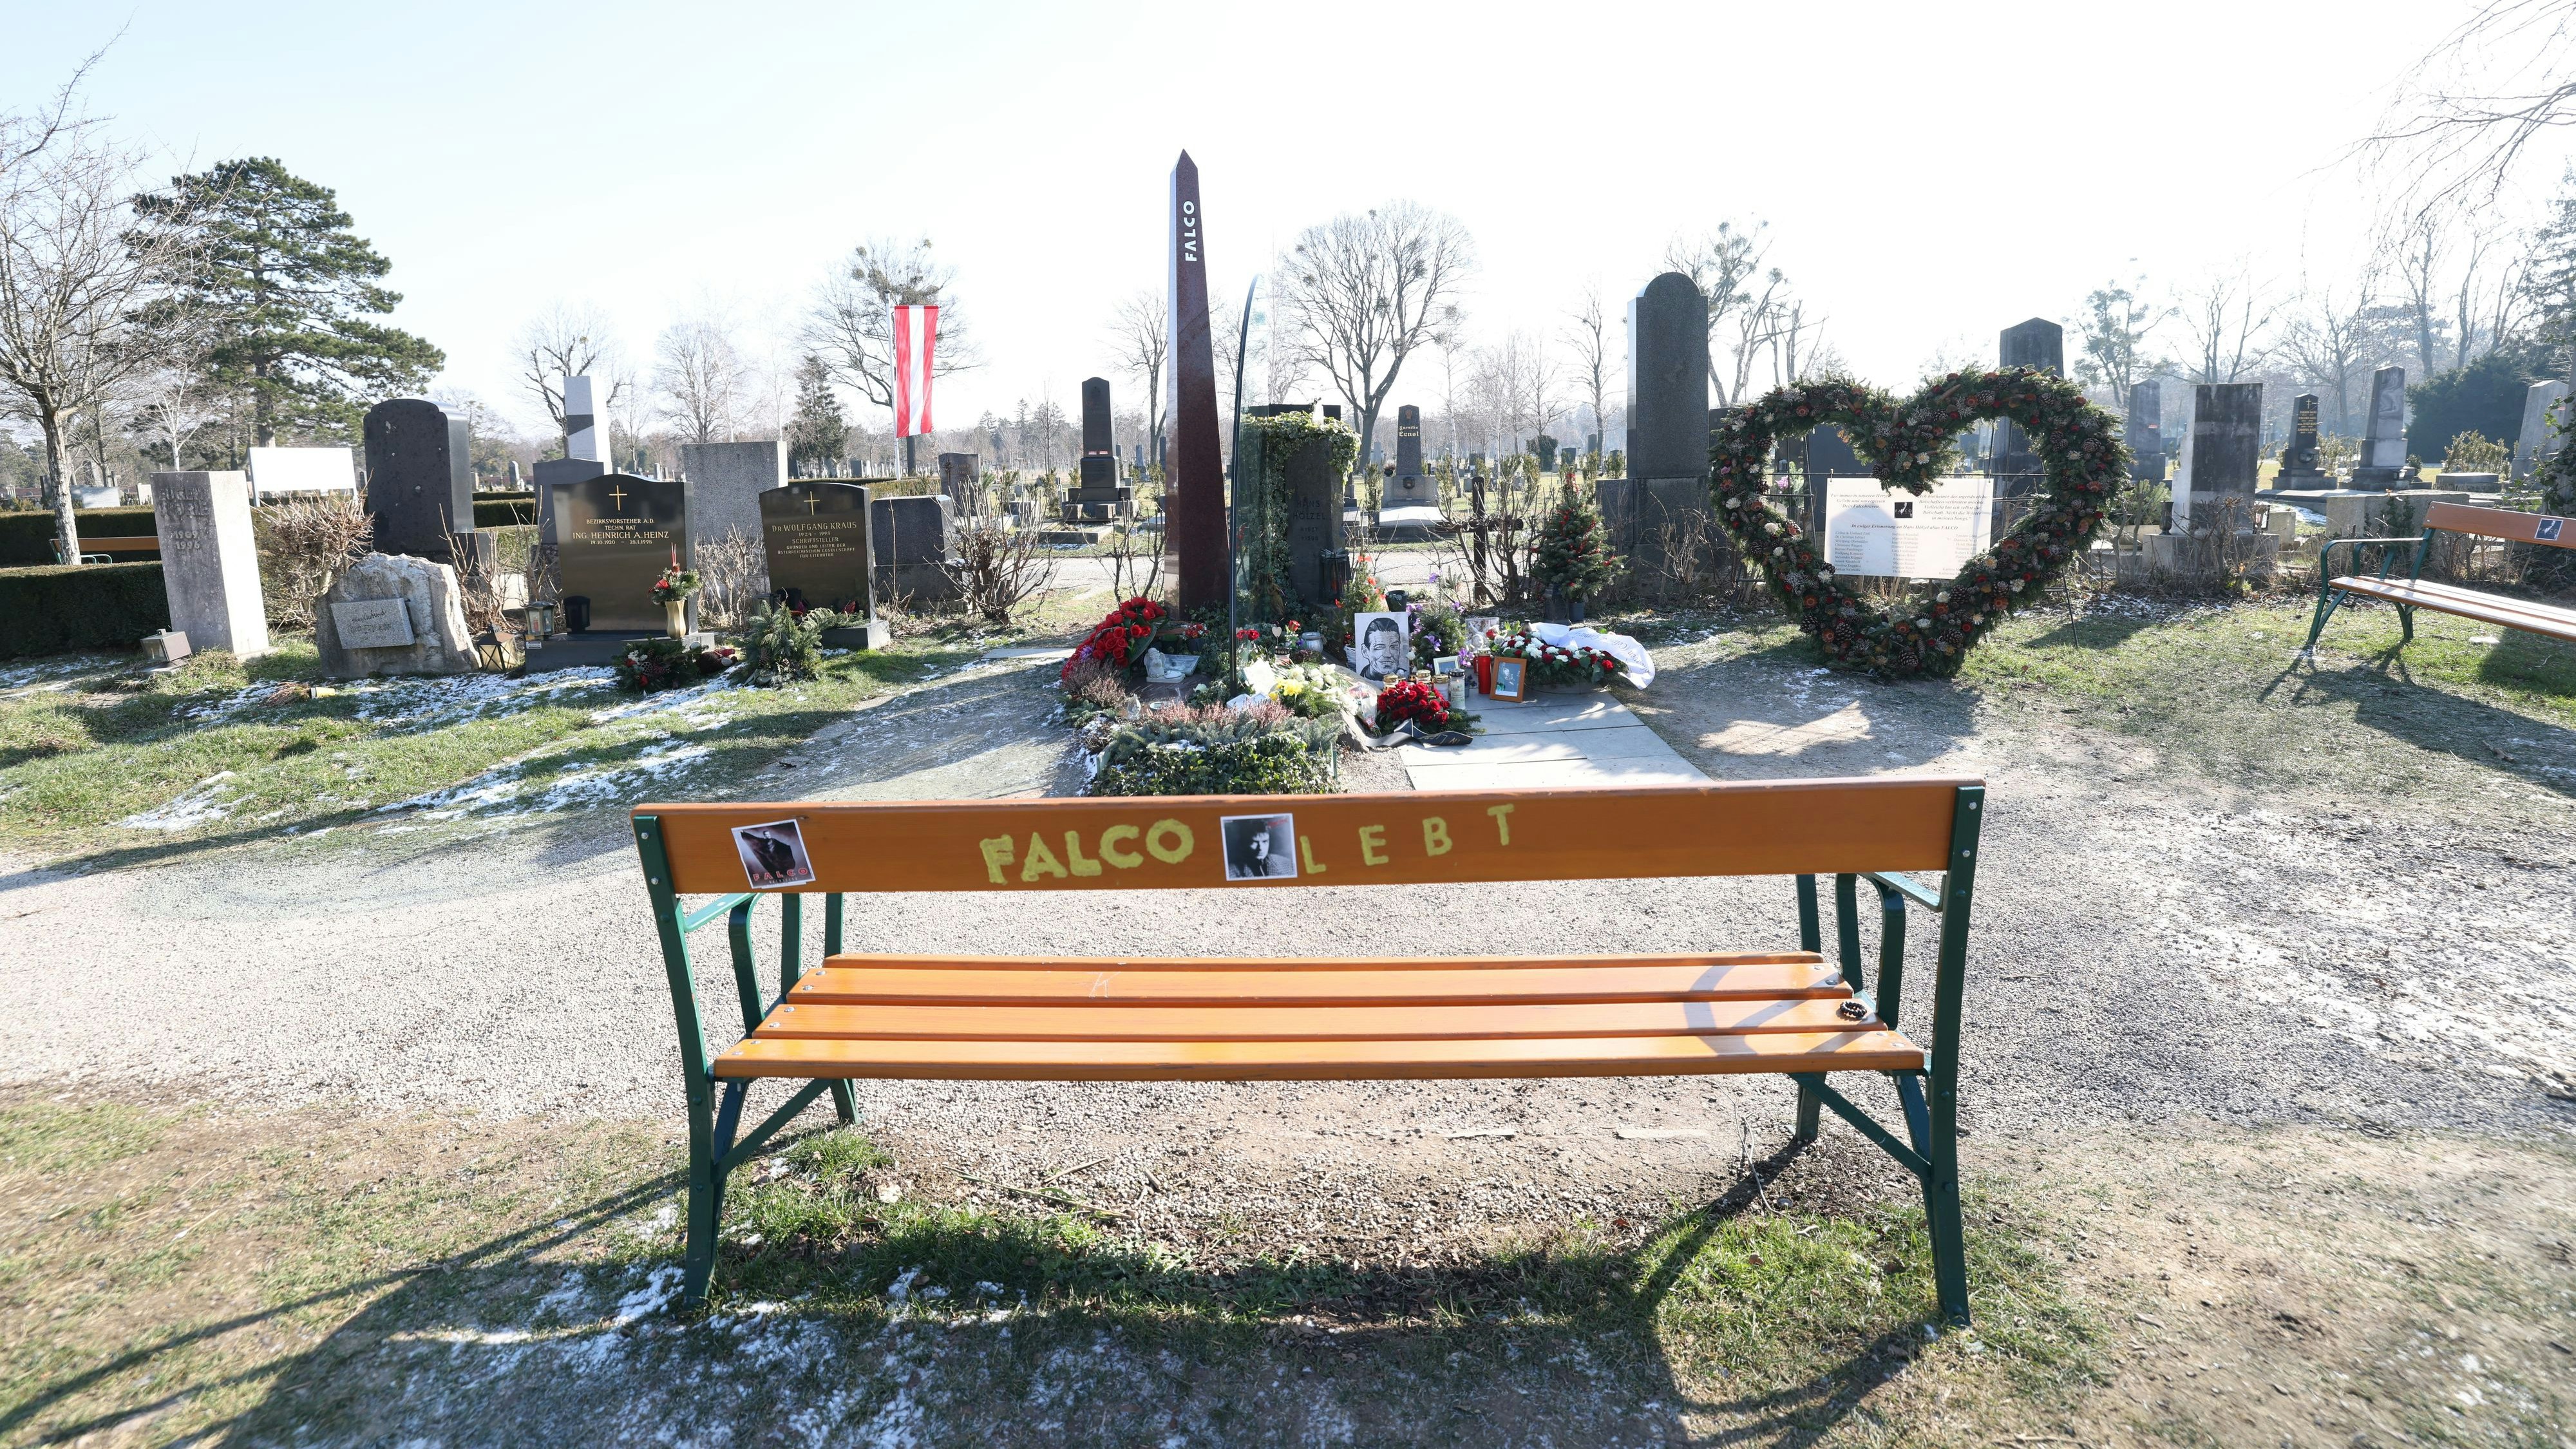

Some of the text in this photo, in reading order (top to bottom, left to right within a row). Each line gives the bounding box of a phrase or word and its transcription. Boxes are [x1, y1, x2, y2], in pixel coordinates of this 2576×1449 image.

[1183, 201, 1197, 261] FALCO
[1293, 510, 1325, 520] HÖLZEL
[783, 523, 828, 532] WOLFGANG
[830, 521, 857, 529] KRAUS
[173, 531, 199, 539] 1909
[176, 541, 200, 550] 1996
[980, 819, 1194, 884] FALCO
[753, 867, 808, 881] FALCO
